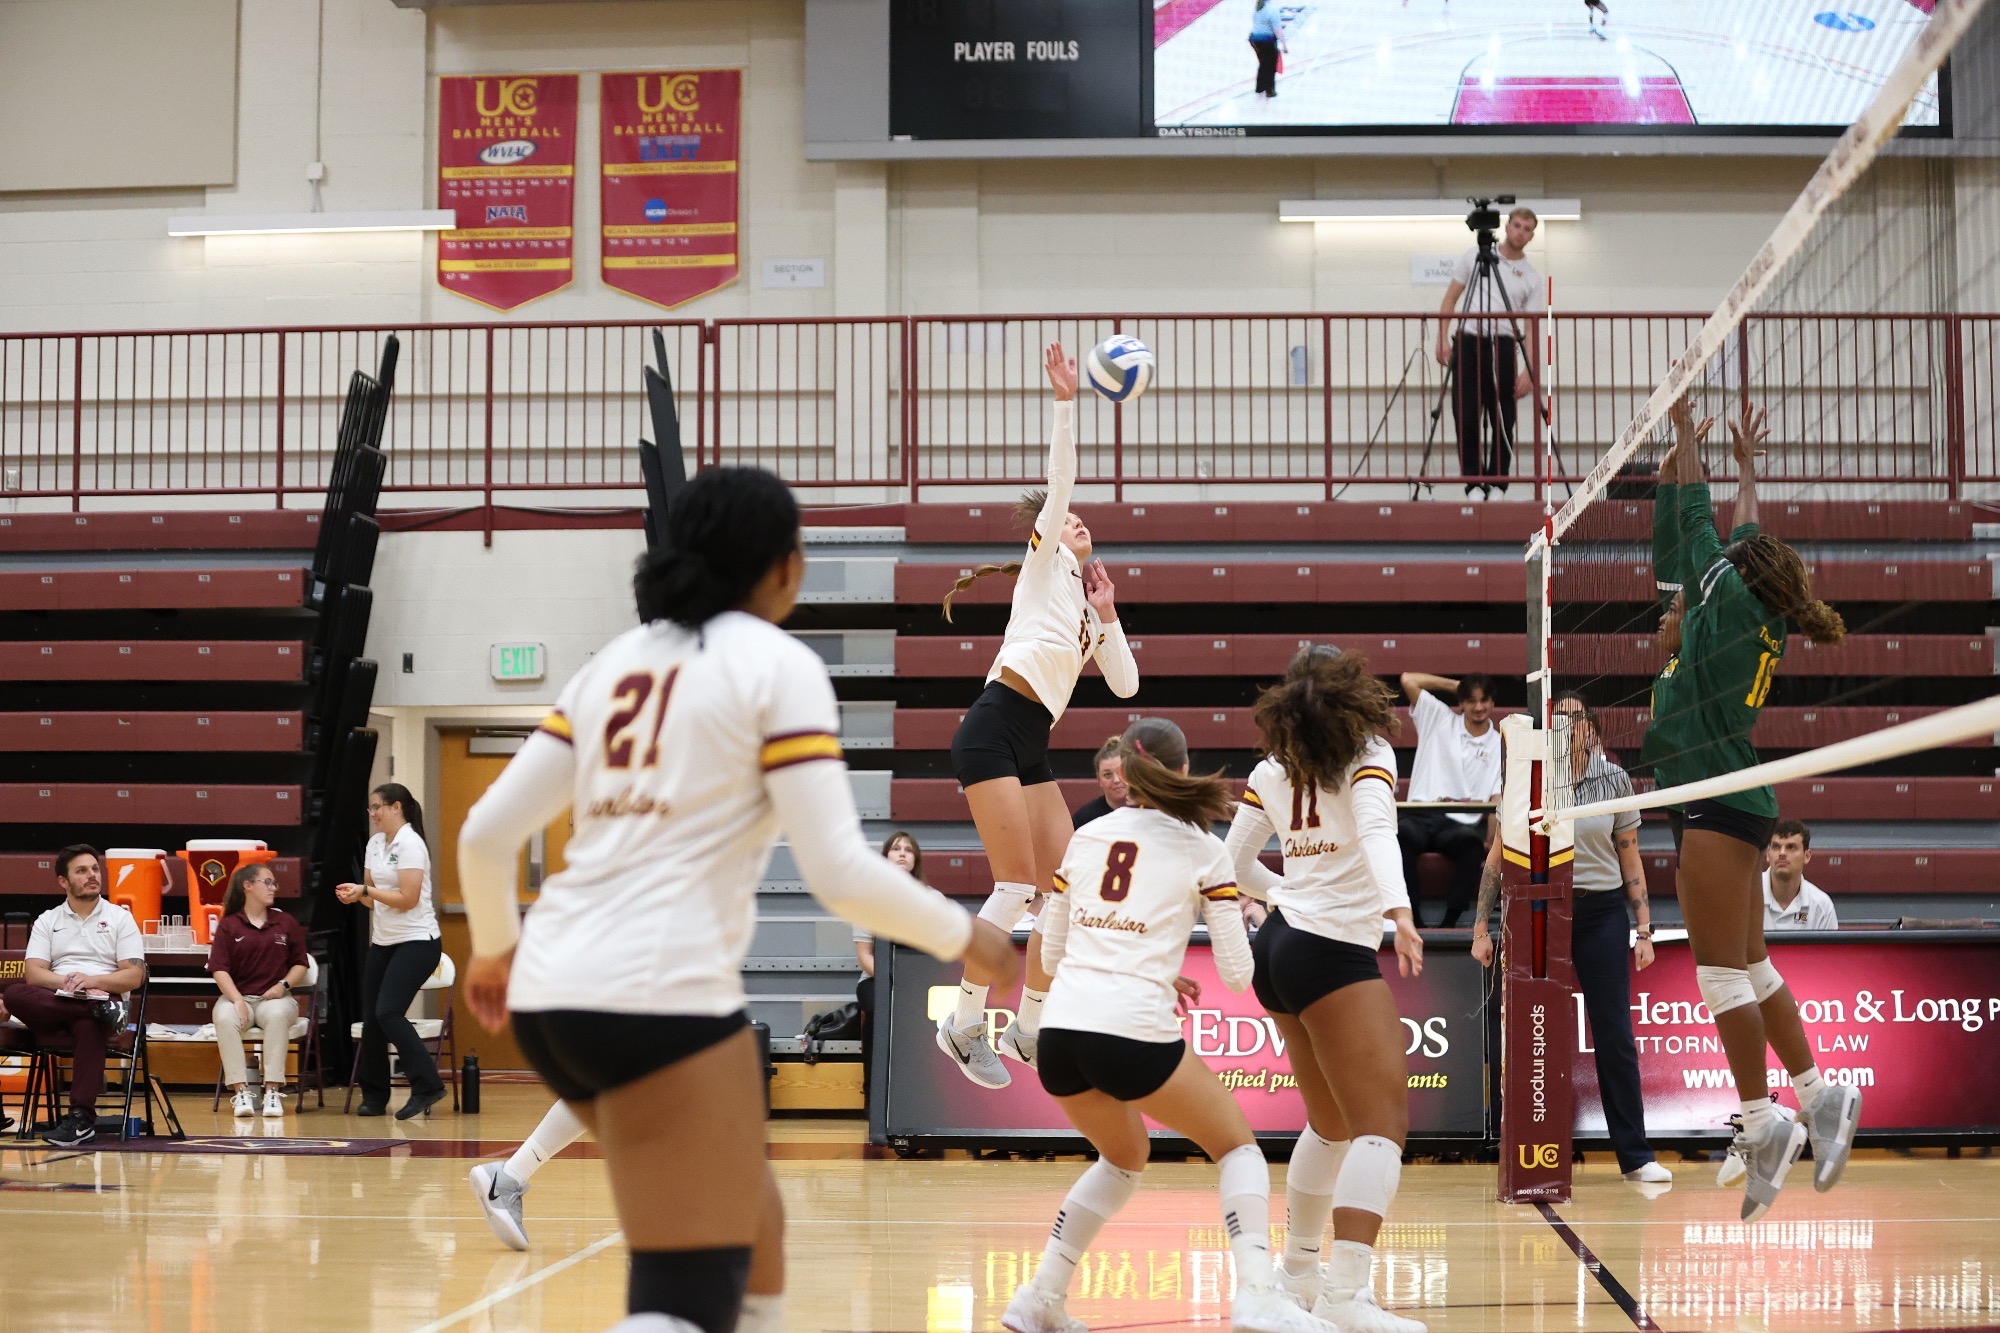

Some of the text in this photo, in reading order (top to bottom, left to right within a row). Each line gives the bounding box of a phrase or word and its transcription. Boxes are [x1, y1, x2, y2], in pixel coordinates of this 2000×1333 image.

[954, 40, 1079, 60] PLAYER FOULS
[476, 79, 537, 116] UC
[637, 74, 699, 112] UC
[481, 116, 532, 126] MEN'S
[614, 123, 723, 135] BASKETBALL
[642, 112, 694, 122] MEN'S
[452, 127, 560, 139] BASKETBALL
[1159, 127, 1246, 136] DAKTRONICS
[486, 206, 527, 221] NAIA
[501, 647, 535, 675] EXIT
[604, 664, 683, 770] 21
[1289, 772, 1321, 832] 11
[1100, 841, 1138, 902] 8
[1072, 907, 1148, 933] Charleston
[1854, 990, 1885, 1023] &
[1891, 990, 1984, 1032] Long
[1530, 1004, 1546, 1061] sports
[1818, 1034, 1869, 1052] LAW
[1519, 1144, 1559, 1169] UC
